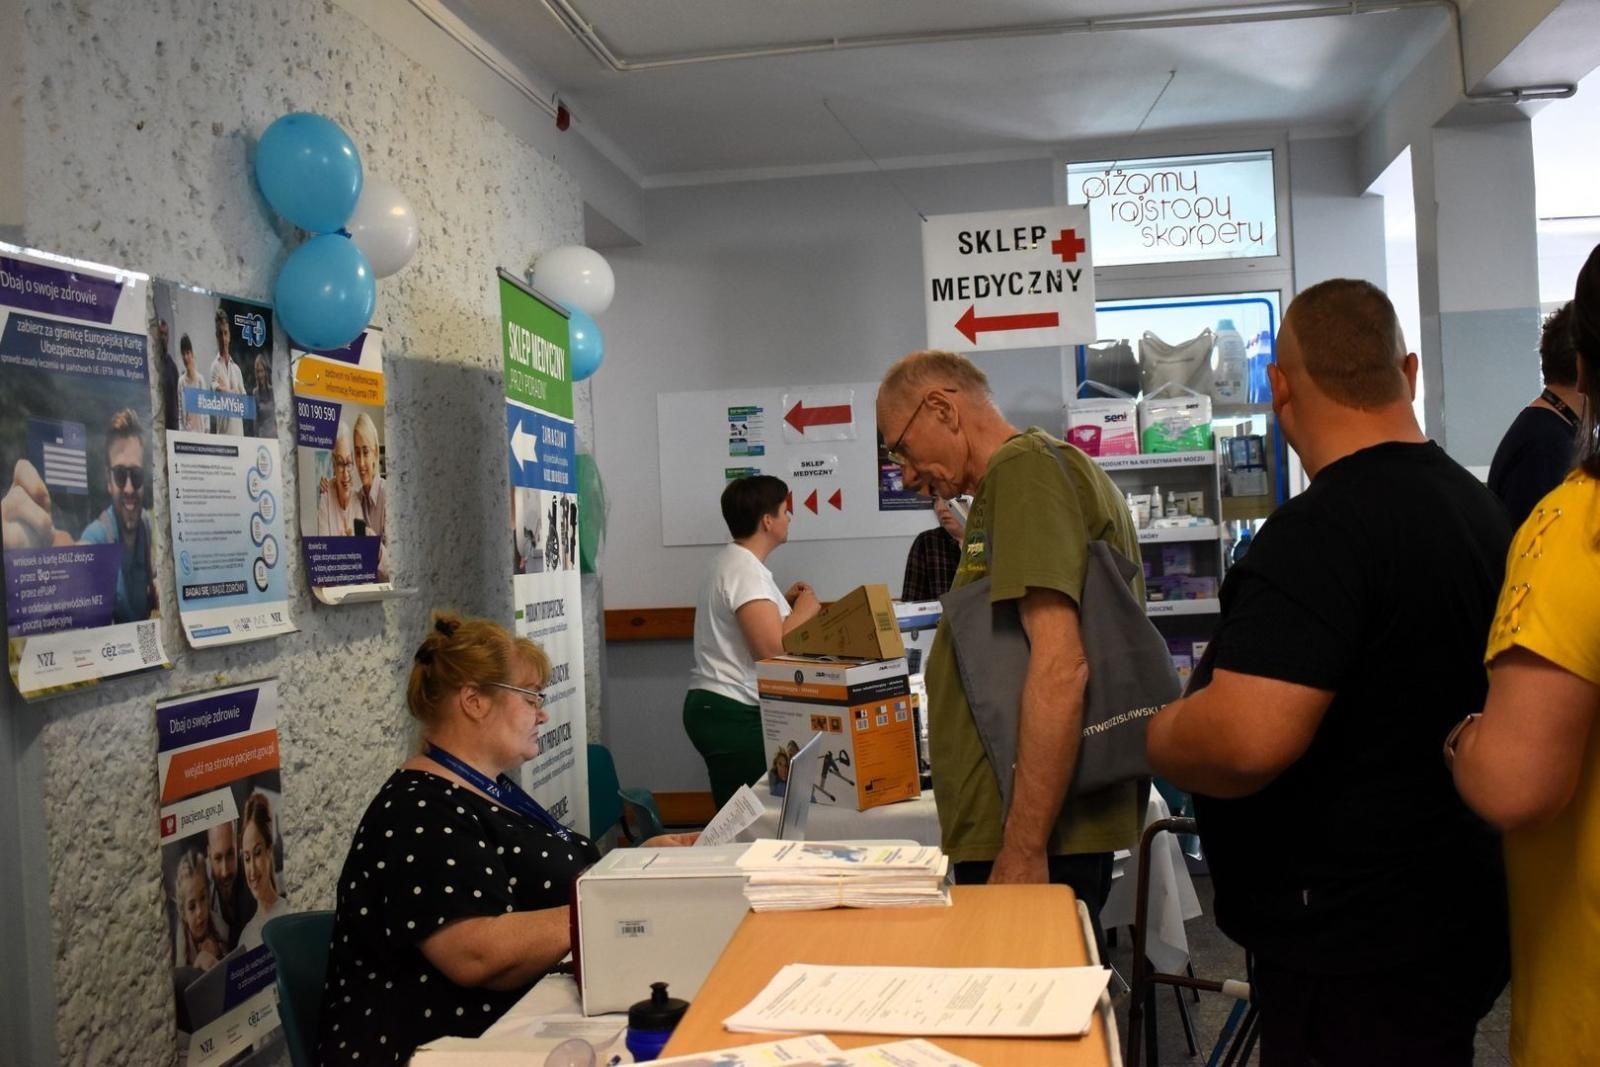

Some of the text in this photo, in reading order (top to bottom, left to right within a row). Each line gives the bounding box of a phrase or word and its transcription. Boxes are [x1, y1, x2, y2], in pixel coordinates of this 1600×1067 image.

[1082, 168, 1198, 202] piżamy
[1111, 195, 1232, 228] rajstopy
[958, 226, 1047, 255] SKLEP
[1141, 221, 1264, 249] skarpety
[1, 272, 97, 306] Dbaj o swoje zdrowie
[932, 269, 1083, 302] MEDYCZNY
[17, 320, 142, 353] zabierz za granicę Europejską Kartę
[508, 320, 565, 382] SKLEP MEDYCZNY
[40, 339, 143, 368] Ubezpieczenia Zdrowotnego
[298, 402, 336, 421] 800 190 590
[1104, 411, 1127, 423] seni
[793, 469, 833, 477] MEDYCZNY
[801, 460, 825, 468] SKLEP
[1130, 459, 1139, 467] NA
[1184, 455, 1206, 463] MOCZU
[170, 716, 186, 734] Dbaj
[192, 710, 212, 728] swoje
[212, 705, 240, 724] zdrowie
[184, 741, 274, 779] wejdź na stronę pacjent.gov.pl
[180, 800, 224, 828] pacjent.gov.pl
